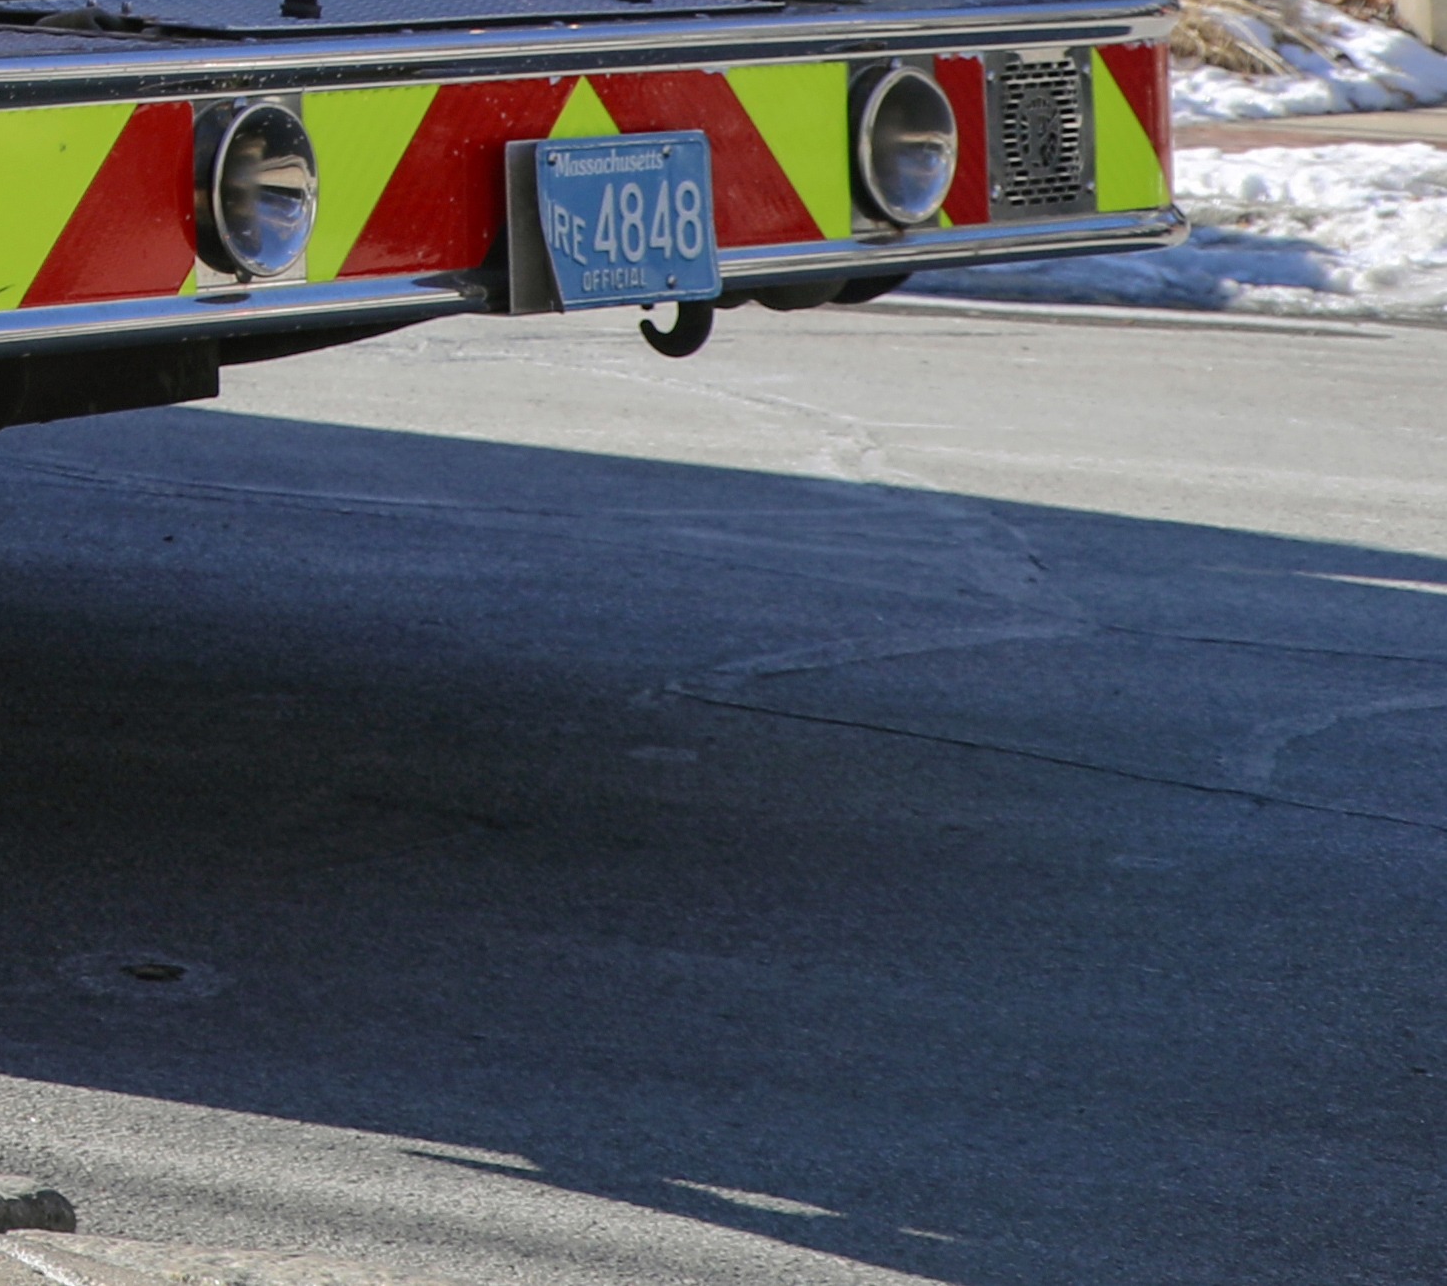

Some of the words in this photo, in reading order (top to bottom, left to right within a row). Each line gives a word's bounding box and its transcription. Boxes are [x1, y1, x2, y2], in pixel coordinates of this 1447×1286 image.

[554, 149, 664, 177] Massachusetts
[545, 192, 588, 266] IRE
[593, 179, 703, 263] 4848
[581, 268, 648, 292] OFFICIAL
